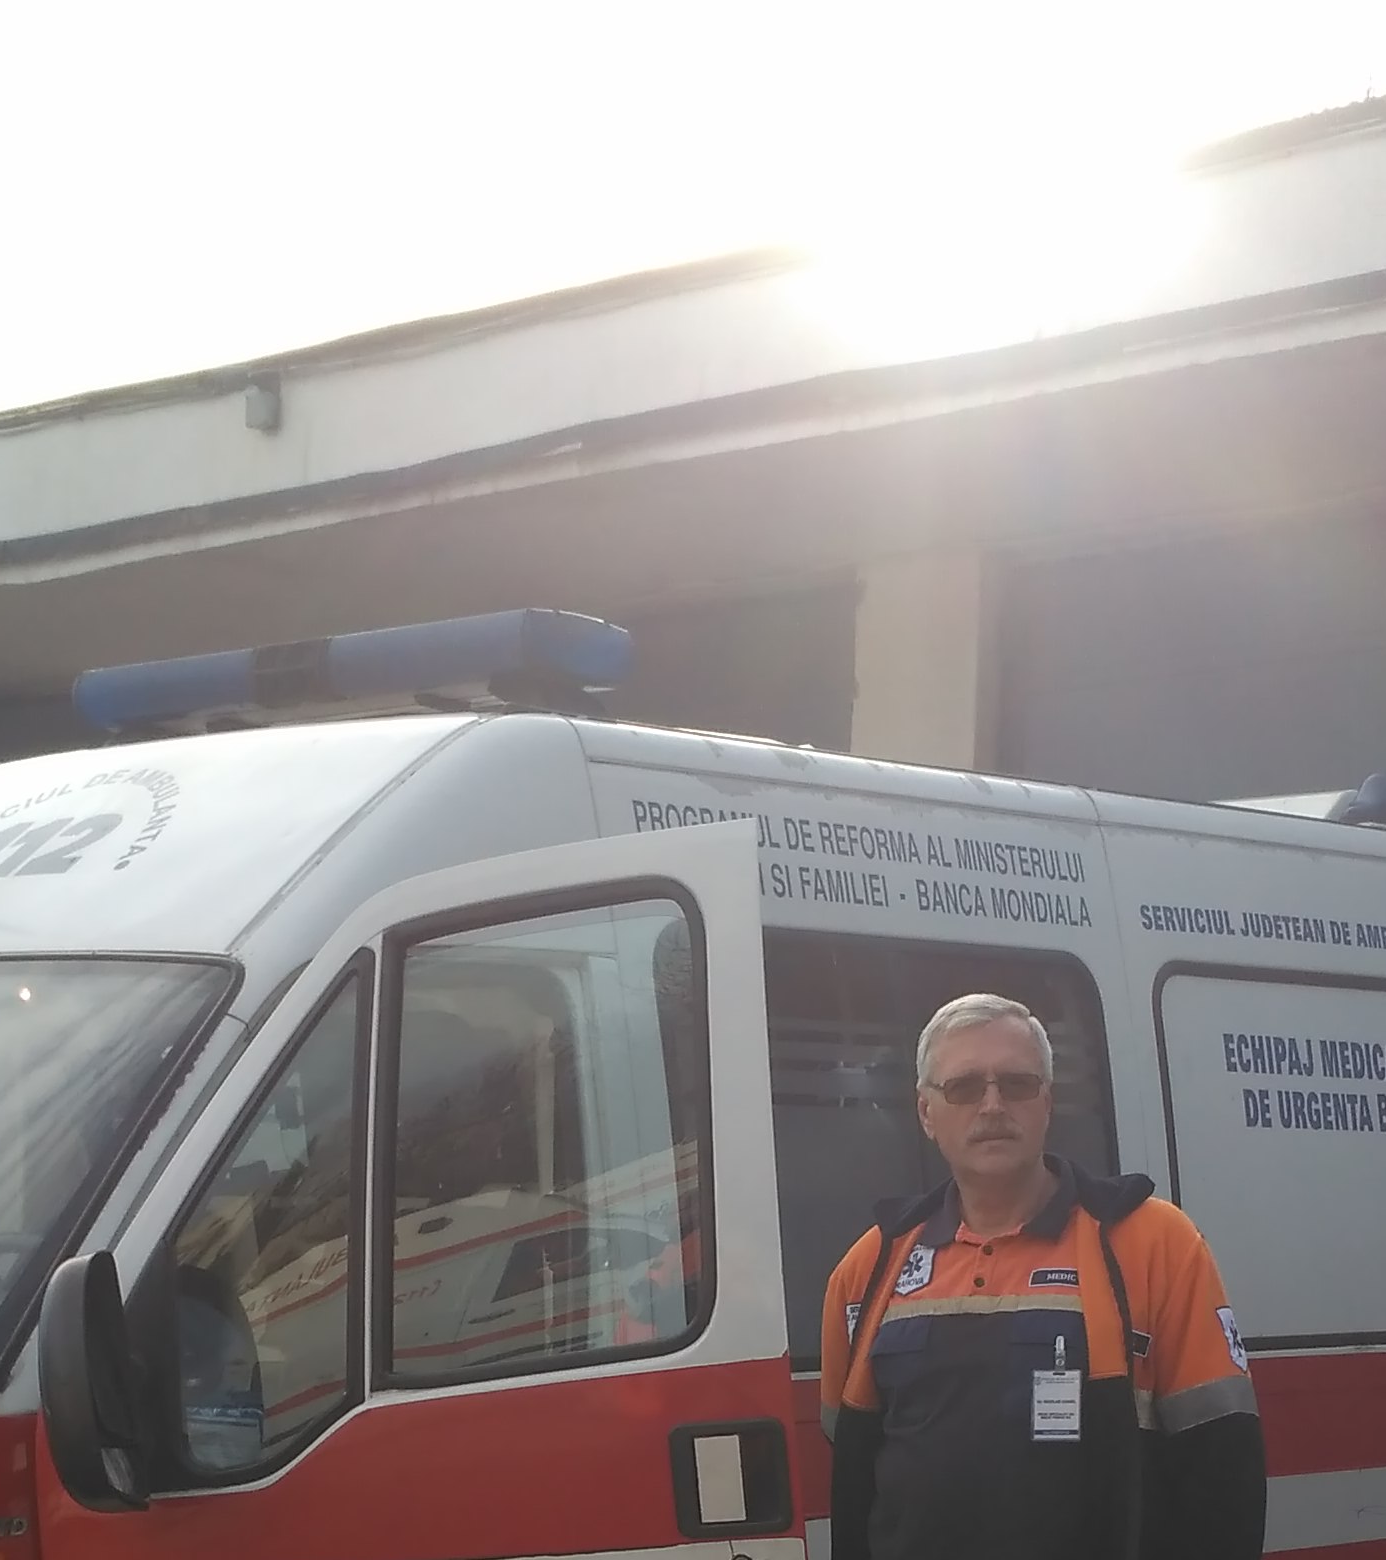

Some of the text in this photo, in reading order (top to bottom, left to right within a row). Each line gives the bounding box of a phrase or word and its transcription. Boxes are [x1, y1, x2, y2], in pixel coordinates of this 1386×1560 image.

[83, 769, 129, 789] DE
[119, 767, 181, 861] AMBULANTA
[783, 817, 815, 853] DE
[817, 821, 922, 865] REFORMA
[927, 834, 952, 868] AL
[954, 837, 1086, 883] MINISTERULUI
[770, 863, 794, 899] SI
[798, 866, 889, 908] FAMILIEI
[915, 878, 988, 918] BANCA
[990, 886, 1093, 928] MONDIALA
[1139, 904, 1236, 936] SERVICIUL
[1240, 911, 1327, 944] JUDETEAN
[1329, 919, 1352, 946] DE
[1222, 1033, 1315, 1078] ECHIPAJ
[1242, 1088, 1273, 1128] DE
[1277, 1090, 1374, 1133] URGENTA
[896, 1277, 925, 1288] RAHOVA
